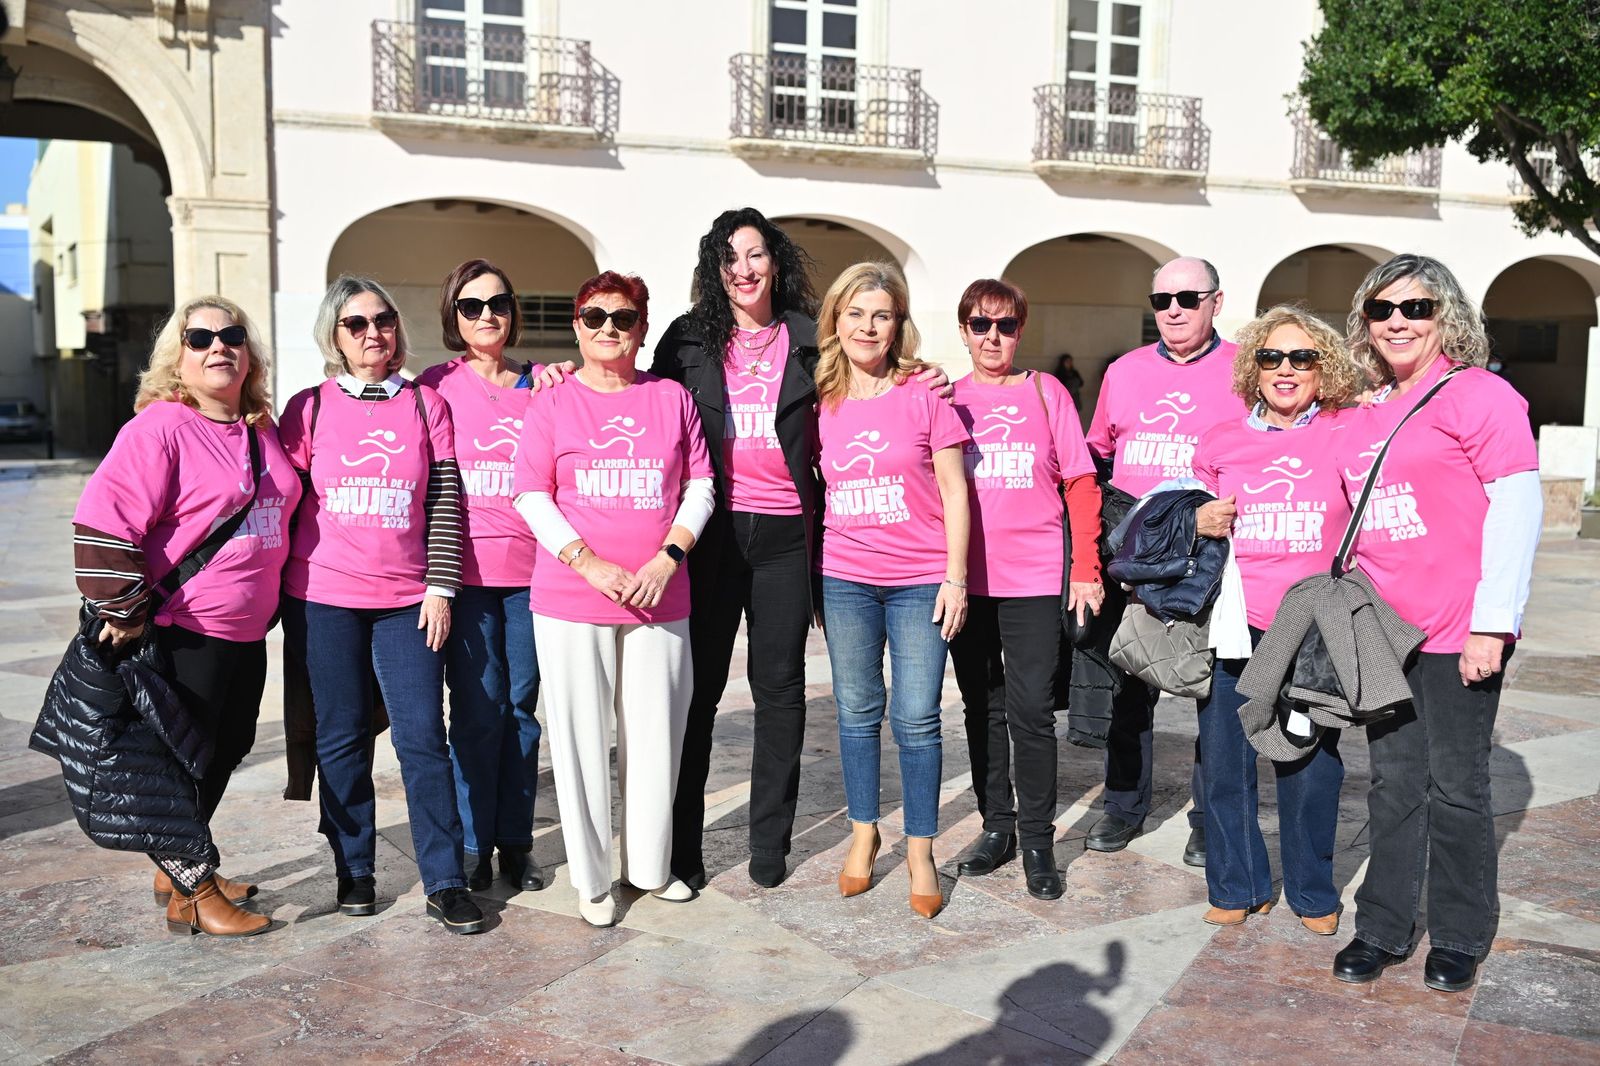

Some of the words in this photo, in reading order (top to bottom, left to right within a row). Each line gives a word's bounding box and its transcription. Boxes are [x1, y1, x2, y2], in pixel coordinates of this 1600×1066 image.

[1135, 432, 1172, 442] CARRERA
[1174, 434, 1186, 444] DE
[1187, 435, 1199, 445] LA
[1011, 442, 1024, 451] DE
[1025, 442, 1036, 452] LA
[1123, 440, 1195, 467] MUJER
[592, 459, 635, 469] CARRERA
[638, 459, 651, 468] DE
[652, 458, 665, 468] LA
[1162, 466, 1194, 478] 2026
[341, 476, 387, 487] CARRERA
[390, 478, 402, 489] DE
[404, 480, 417, 491] LA
[574, 469, 664, 497] MUJER
[837, 478, 877, 490] CARRERA
[878, 476, 890, 486] DE
[892, 475, 904, 484] LA
[1005, 477, 1034, 489] 2026
[1386, 484, 1398, 496] DE
[1398, 482, 1414, 493] LA
[275, 497, 286, 506] LA
[325, 487, 412, 517] MUJER
[633, 497, 664, 510] 2026
[830, 484, 907, 516] MUJER
[1244, 502, 1293, 514] CARRERA
[1296, 501, 1311, 512] DE
[1313, 501, 1327, 512] LA
[381, 516, 410, 528] 2026
[878, 509, 911, 525] 2026
[1233, 511, 1325, 541] MUJER
[1389, 522, 1428, 542] 2026
[1288, 539, 1323, 553] 2026
